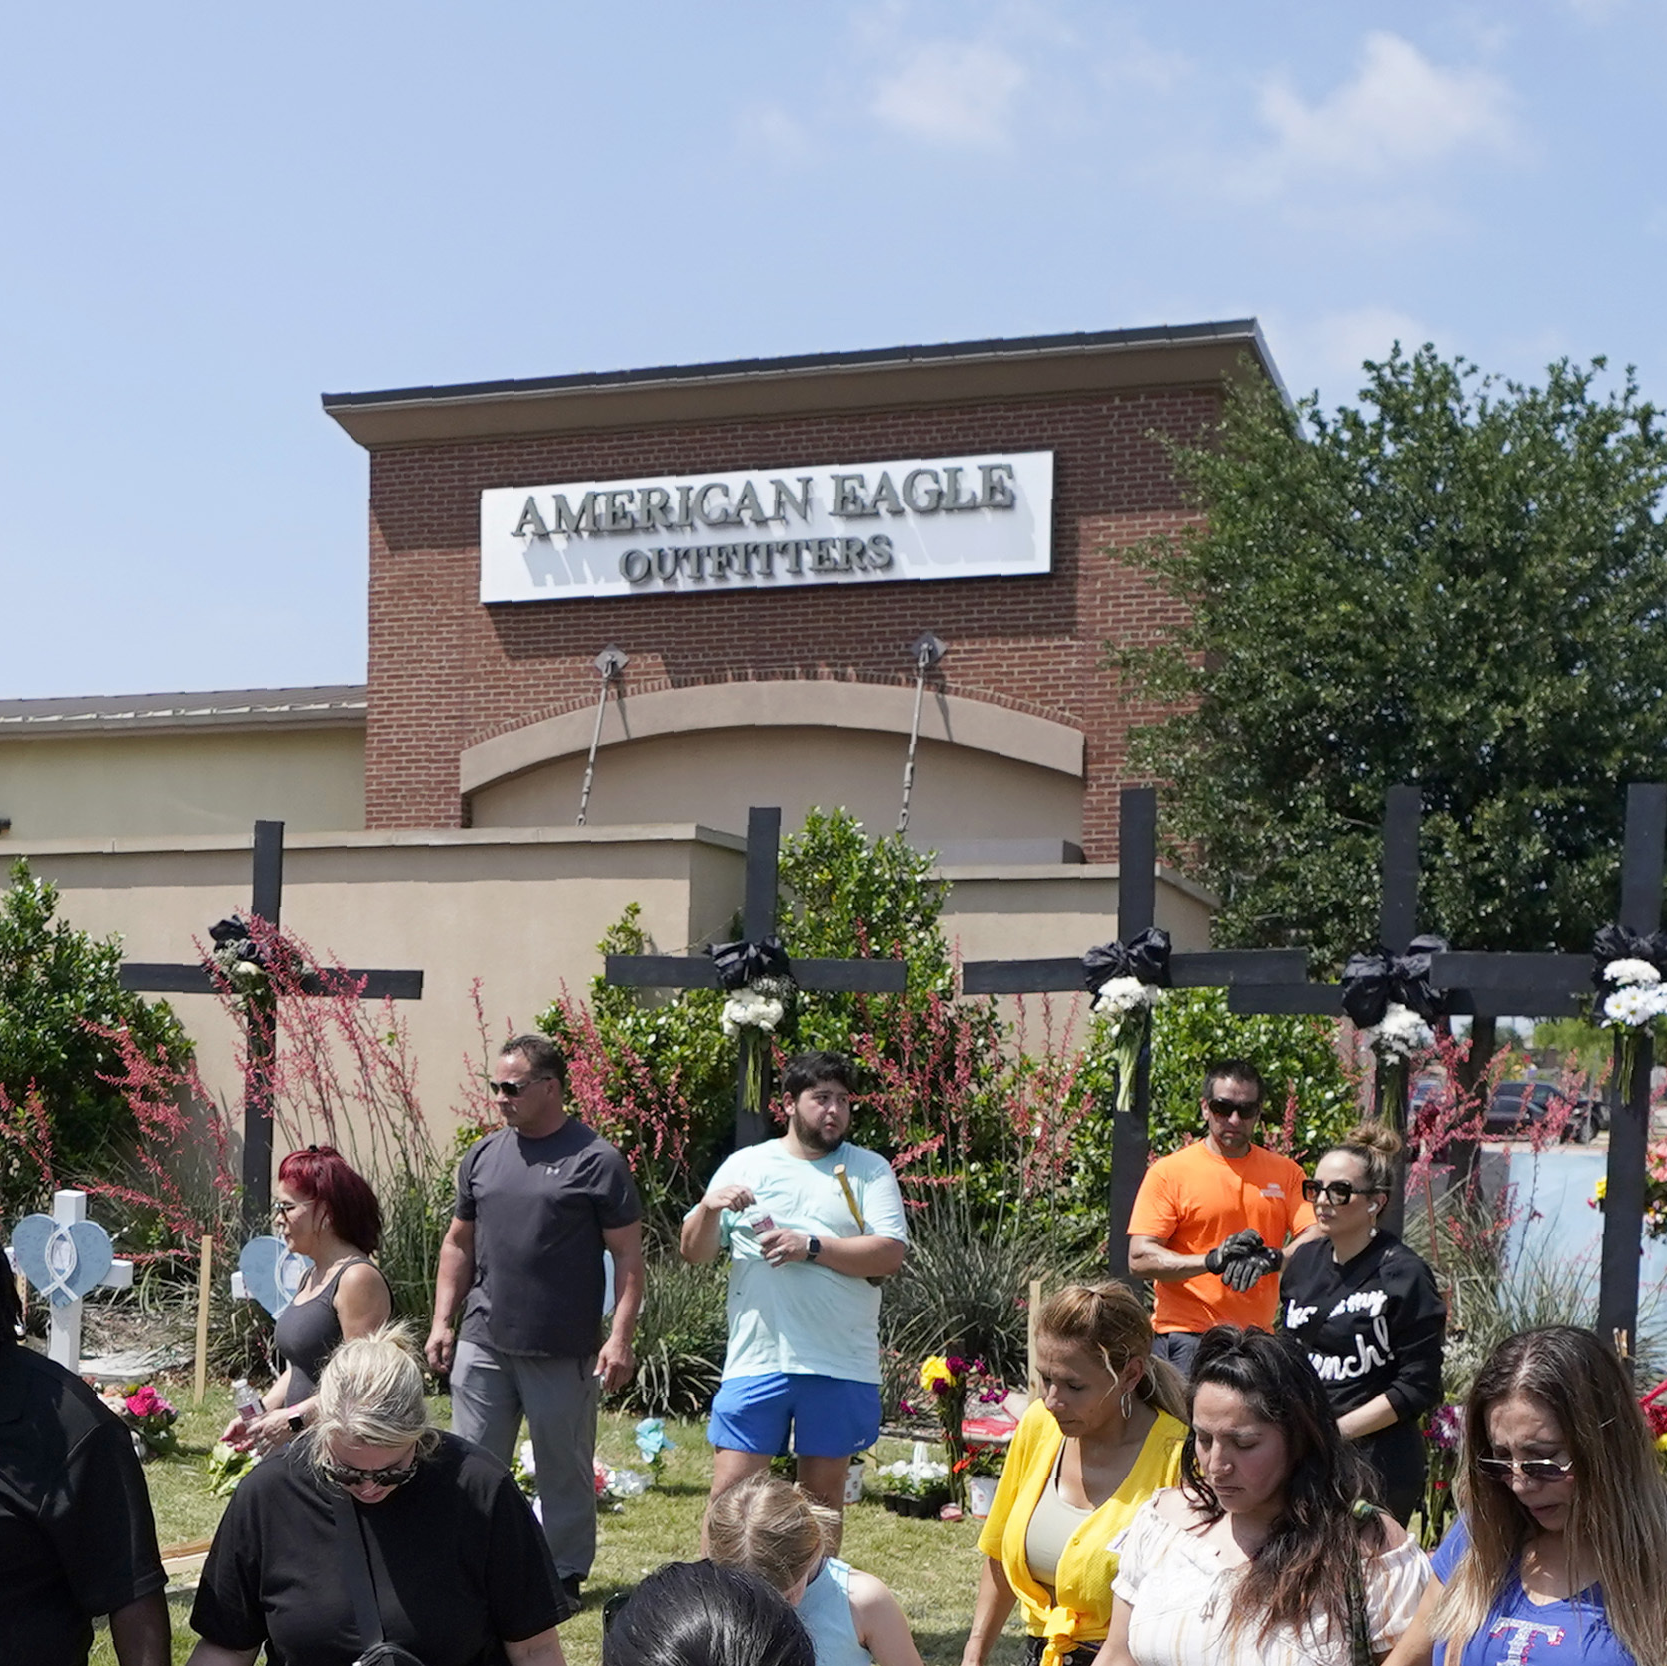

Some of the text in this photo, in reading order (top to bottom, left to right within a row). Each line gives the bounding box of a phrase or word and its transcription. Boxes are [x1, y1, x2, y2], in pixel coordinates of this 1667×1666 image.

[512, 464, 1014, 537] AMERICAN EAGLE
[620, 534, 892, 585] OUTFITTERS
